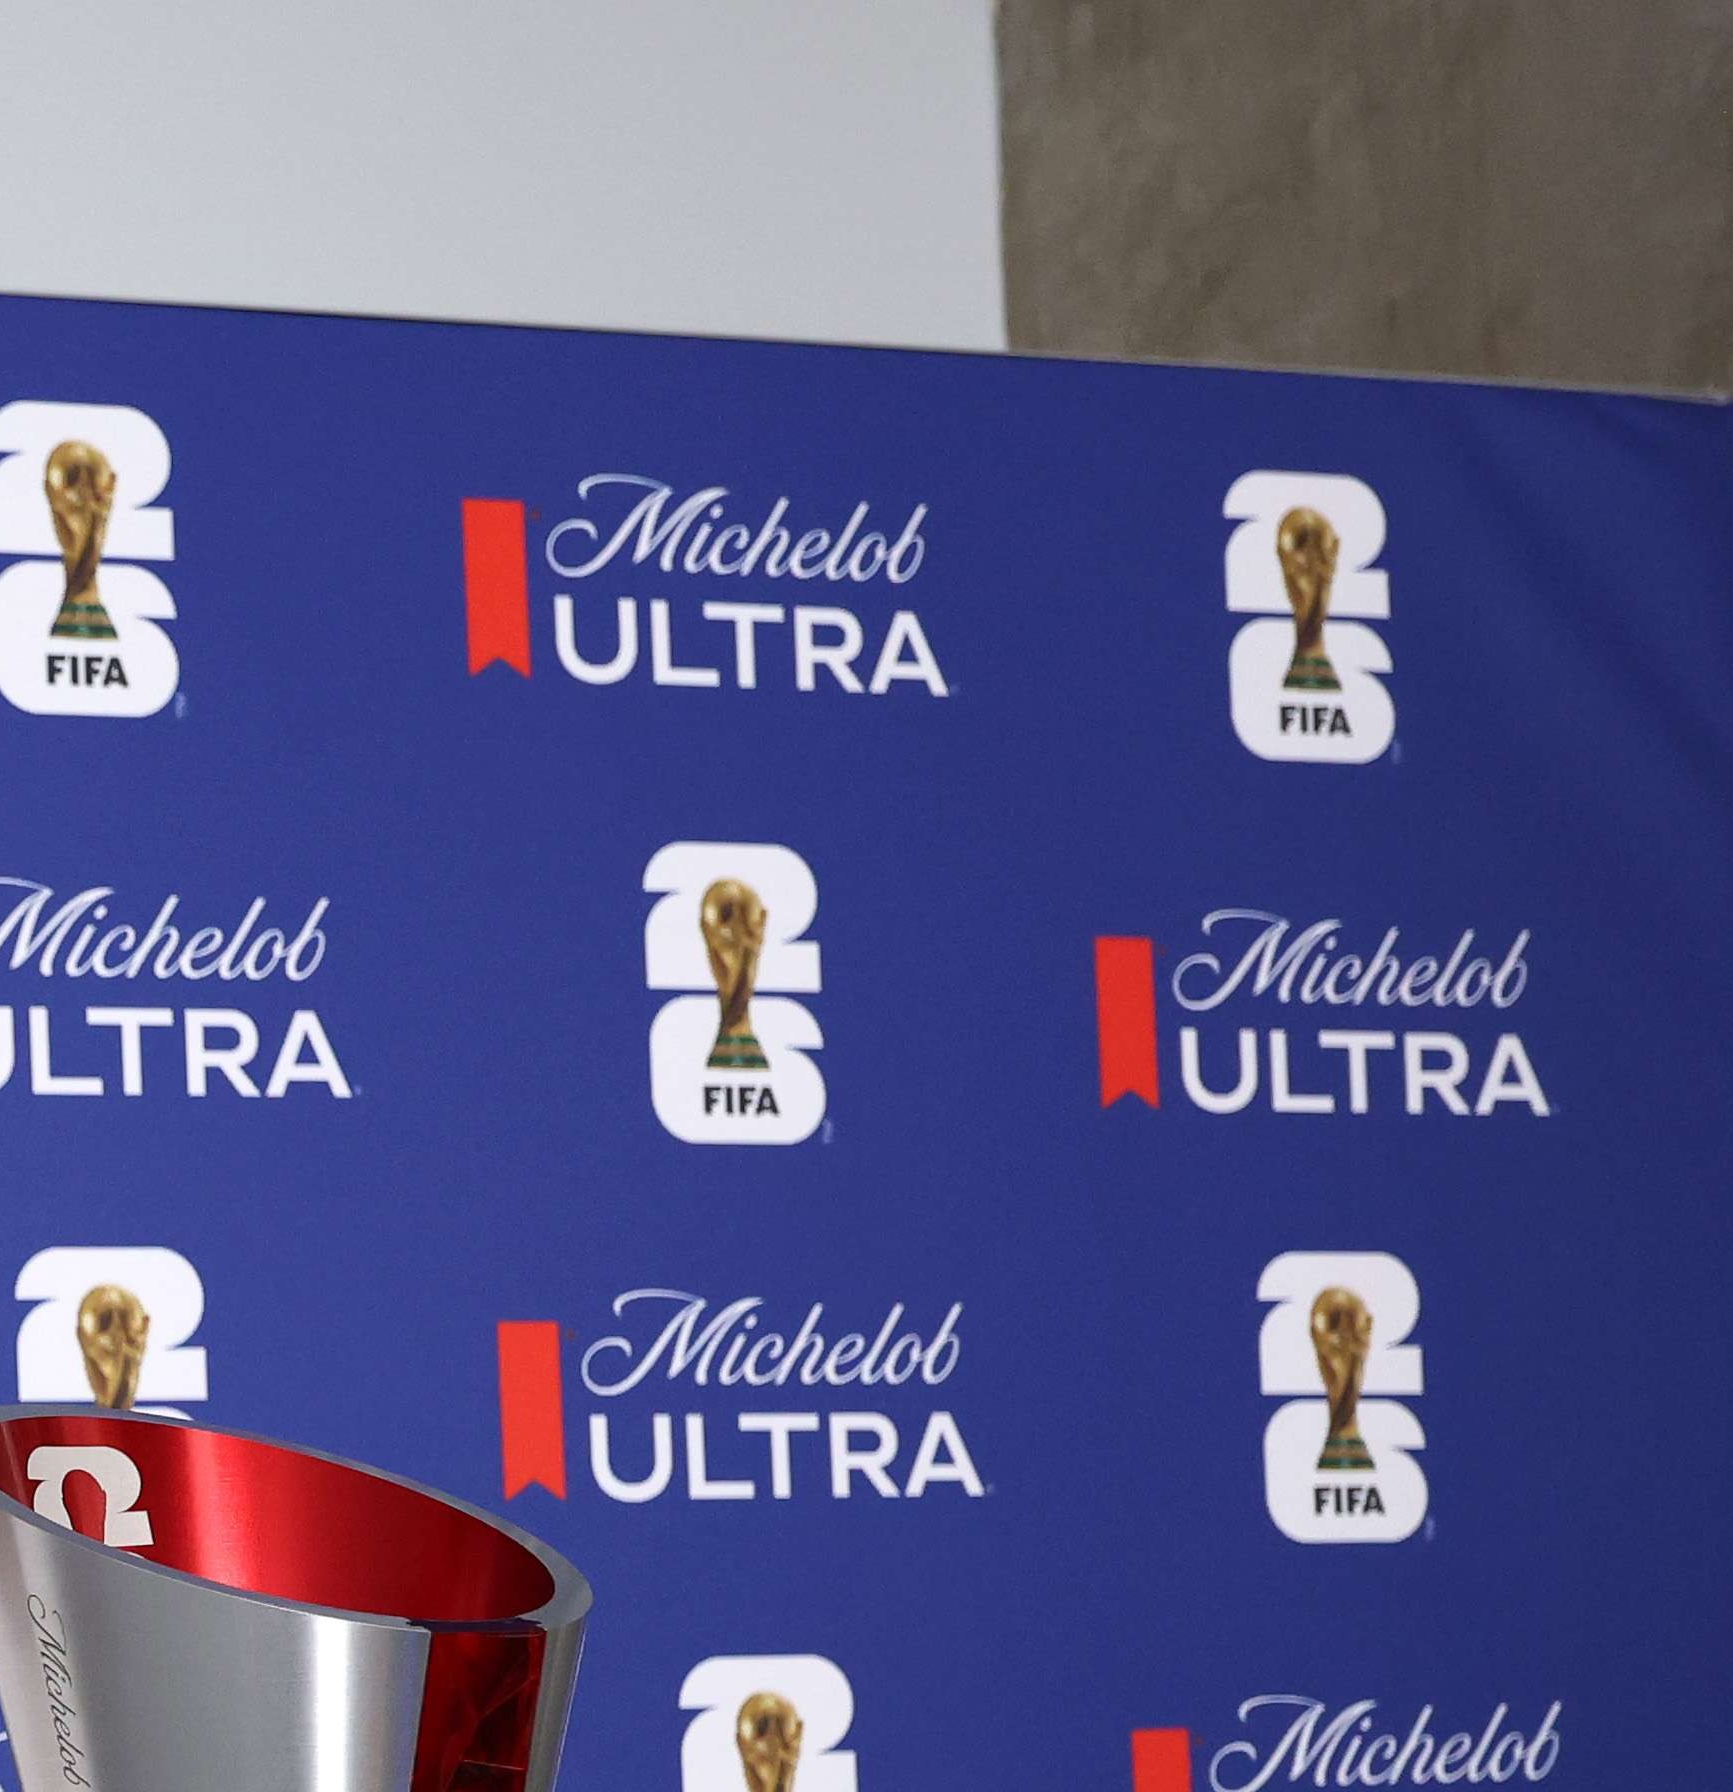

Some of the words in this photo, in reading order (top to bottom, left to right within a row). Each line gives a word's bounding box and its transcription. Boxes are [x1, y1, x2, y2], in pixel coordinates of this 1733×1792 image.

[545, 474, 927, 584] Michelob
[46, 655, 129, 688] FIFA
[553, 594, 949, 697] ULTRA
[1279, 705, 1351, 735] FIFA
[1172, 909, 1530, 1011] Michelob
[703, 1085, 780, 1115] FIFA
[1179, 1027, 1550, 1117] ULTRA
[581, 1288, 962, 1396] Michelob
[589, 1411, 985, 1503] ULTRA
[1313, 1486, 1385, 1515] FIFA
[26, 1593, 91, 1789] Michelob
